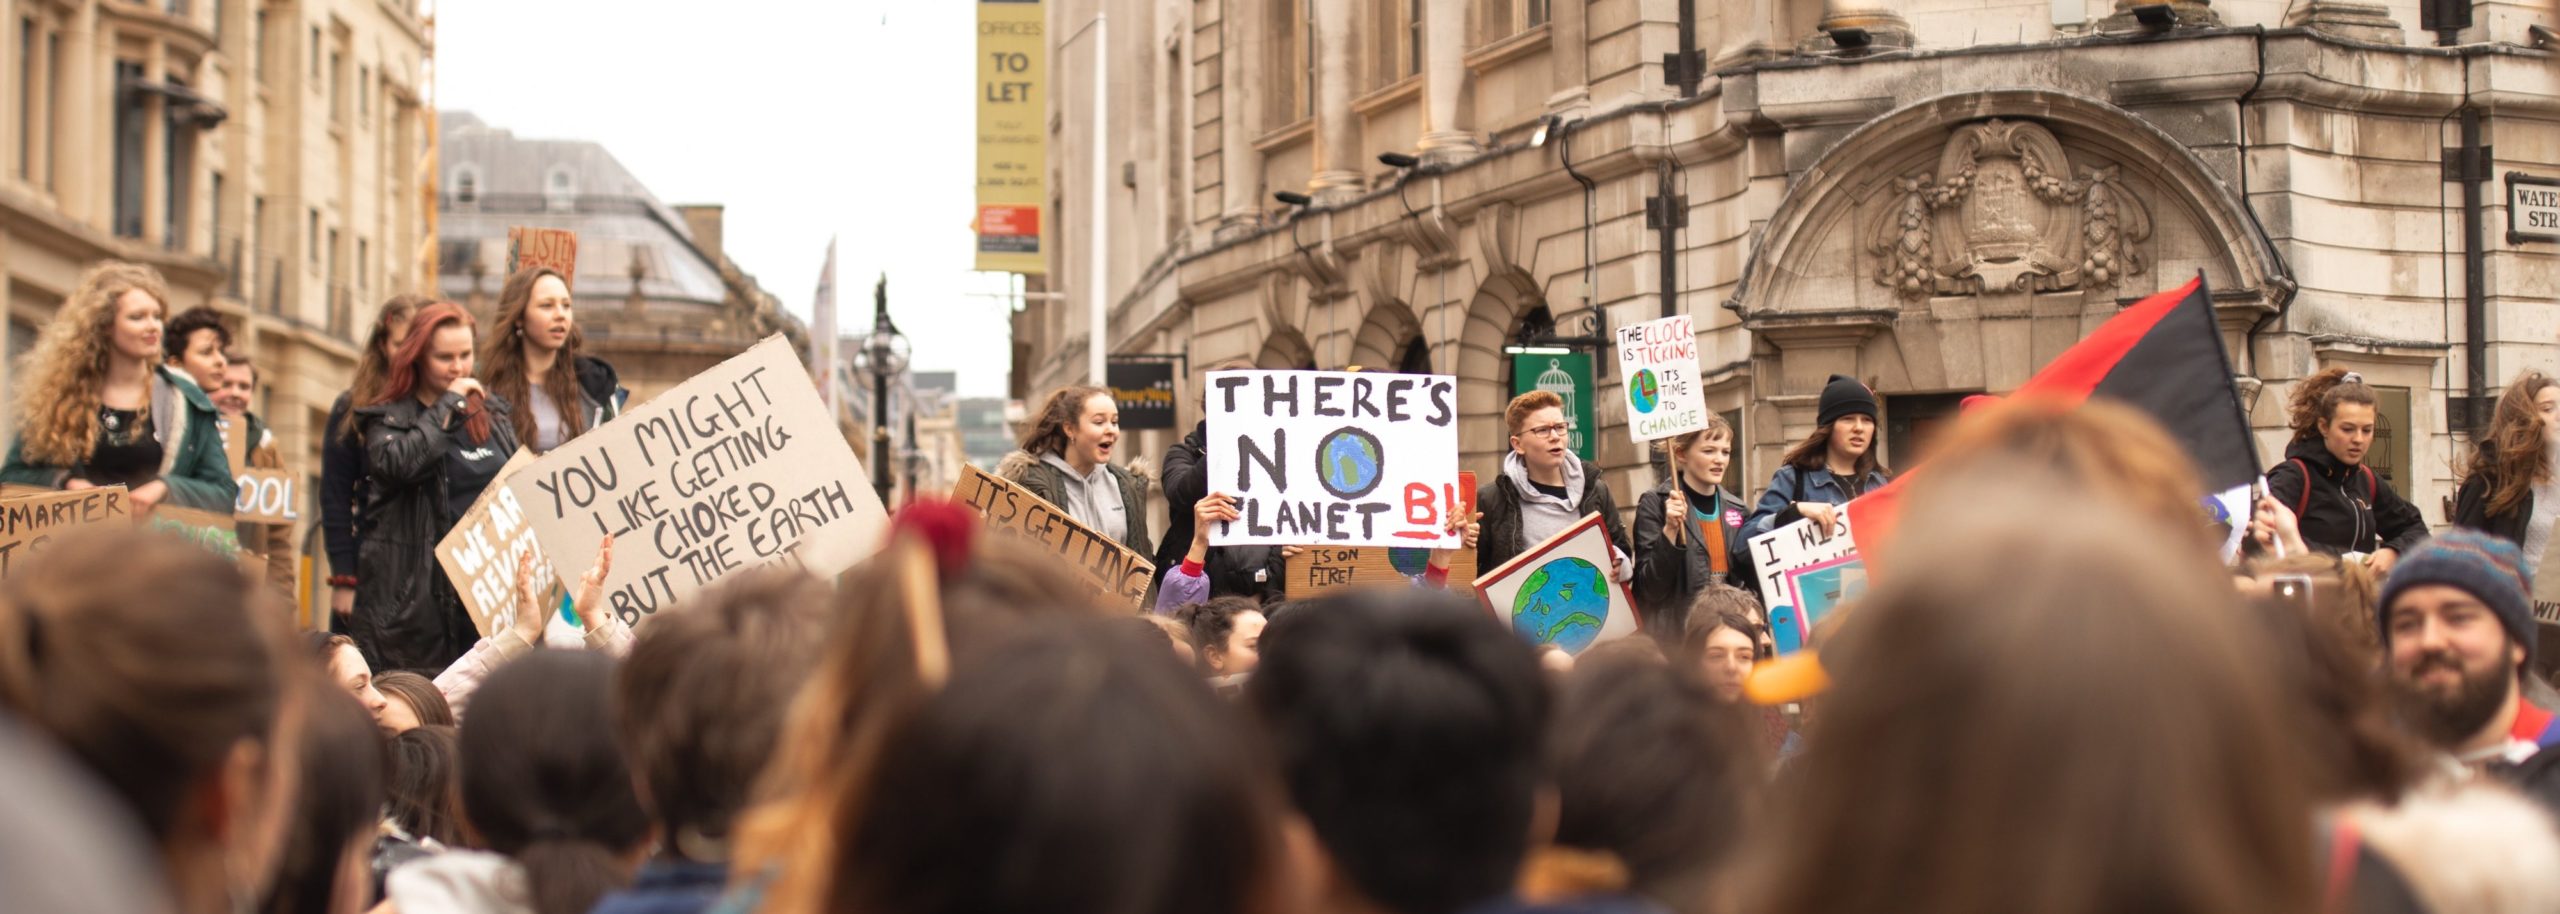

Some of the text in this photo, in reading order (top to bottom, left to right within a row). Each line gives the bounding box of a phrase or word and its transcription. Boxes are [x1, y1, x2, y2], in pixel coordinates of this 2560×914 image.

[991, 52, 1029, 73] TO
[987, 82, 1034, 102] LET
[2517, 189, 2558, 207] WATE
[2529, 211, 2558, 228] STR
[519, 227, 577, 262] LISTEN
[1620, 319, 1694, 346] THE CLOCK
[1623, 343, 1695, 365] IS TICKING
[1661, 369, 1679, 382] IT'S
[1216, 375, 1452, 427] THERE'S
[1660, 381, 1687, 396] TIME
[1662, 401, 1676, 411] TO
[1640, 410, 1697, 435] CHANGE
[536, 447, 617, 519] YOU
[634, 366, 772, 467] MIGHT
[593, 415, 792, 539] LIKE GETTING
[654, 482, 775, 559] CHOKED
[452, 522, 495, 576] WE
[966, 472, 1019, 523] IT'S
[1024, 505, 1151, 602] GETTING
[609, 566, 677, 628] BUT
[680, 534, 742, 586] THE
[747, 480, 854, 558] EARTH
[1312, 548, 1358, 565] IS ON
[1760, 537, 1781, 566] I
[1310, 566, 1354, 587] FIRE!
